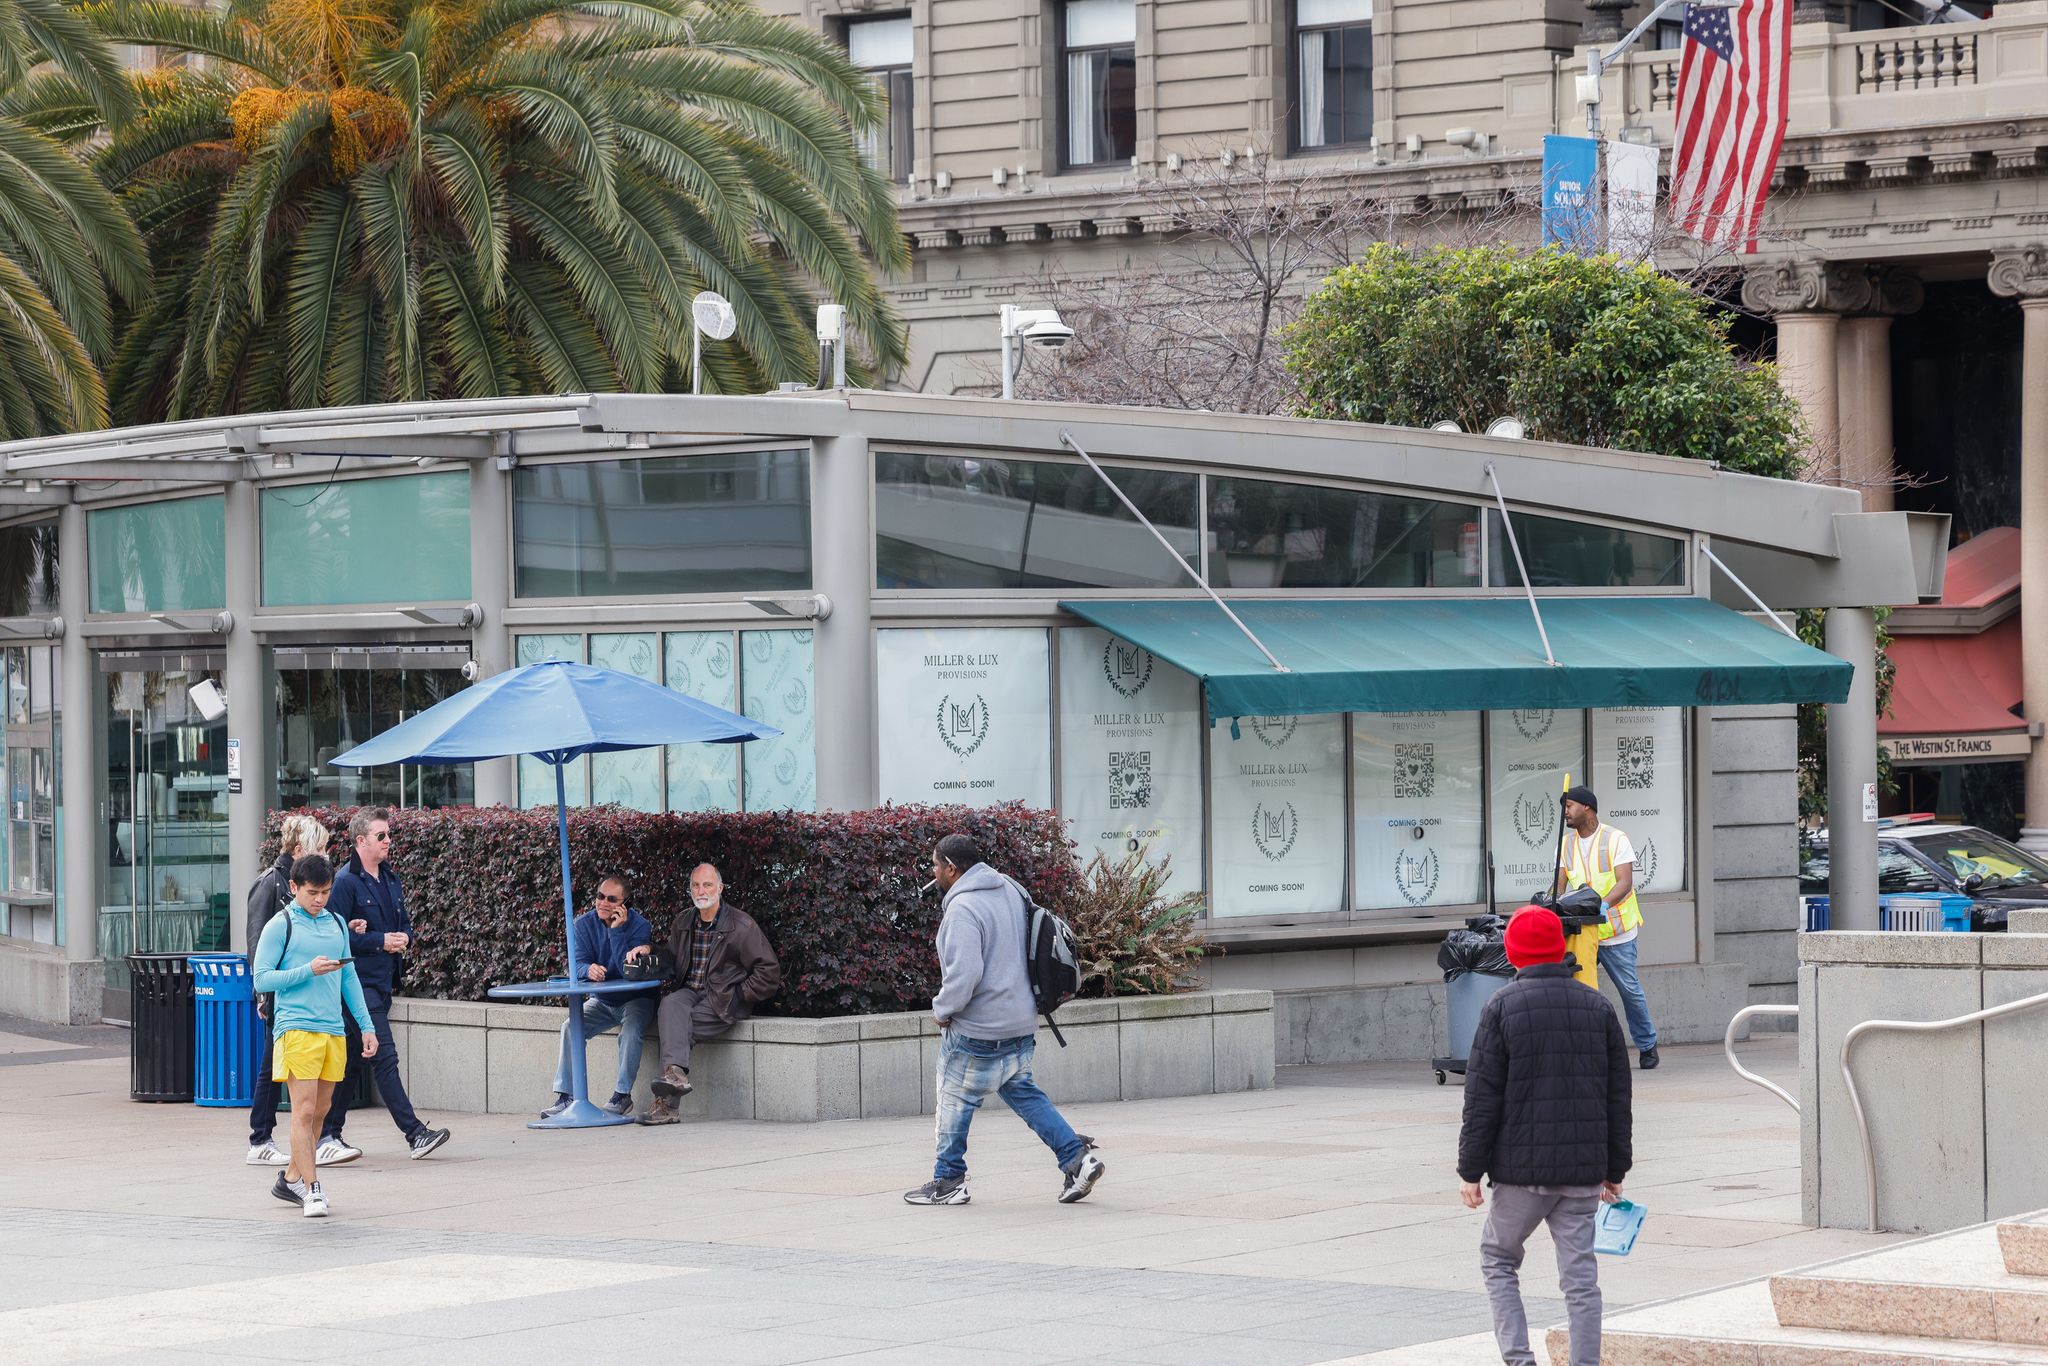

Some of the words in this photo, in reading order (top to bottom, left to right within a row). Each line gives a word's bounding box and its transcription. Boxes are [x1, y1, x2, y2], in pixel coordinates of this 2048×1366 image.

[924, 655, 964, 667] MILLER
[966, 654, 975, 666] &
[978, 654, 999, 666] LUX
[937, 670, 988, 680] PROVISIONS
[1094, 714, 1131, 726] MILLER
[1134, 714, 1141, 725] &
[1144, 713, 1165, 724] LUX
[1615, 716, 1655, 724] PROVISIONS
[1392, 721, 1436, 731] PROVISIONS
[1106, 729, 1153, 738] PROVISIONS
[1894, 741, 1911, 755] THE
[1912, 740, 1943, 754] WESTIN
[1944, 739, 1956, 753] ST.
[1957, 739, 1992, 752] FRANCIS
[1240, 764, 1276, 775] MILLER
[1278, 764, 1286, 775] &
[1288, 763, 1308, 774] LUX
[1507, 763, 1535, 772] COMING
[1537, 762, 1560, 771] SOON!
[933, 781, 967, 790] COMING
[970, 780, 995, 789] SOON!
[1251, 778, 1296, 788] PROVISIONS
[1609, 809, 1638, 818] COMING
[1640, 809, 1660, 817] SOON!
[1388, 819, 1417, 828] COMING
[1419, 818, 1442, 826] SOON!
[1101, 831, 1133, 840] COMING
[1136, 830, 1161, 839] SOON!
[1504, 863, 1537, 875] MILLER
[1539, 863, 1546, 873] &
[1515, 877, 1554, 887] PROVISION
[1248, 884, 1279, 893] COMING
[1281, 883, 1305, 891] SOON!
